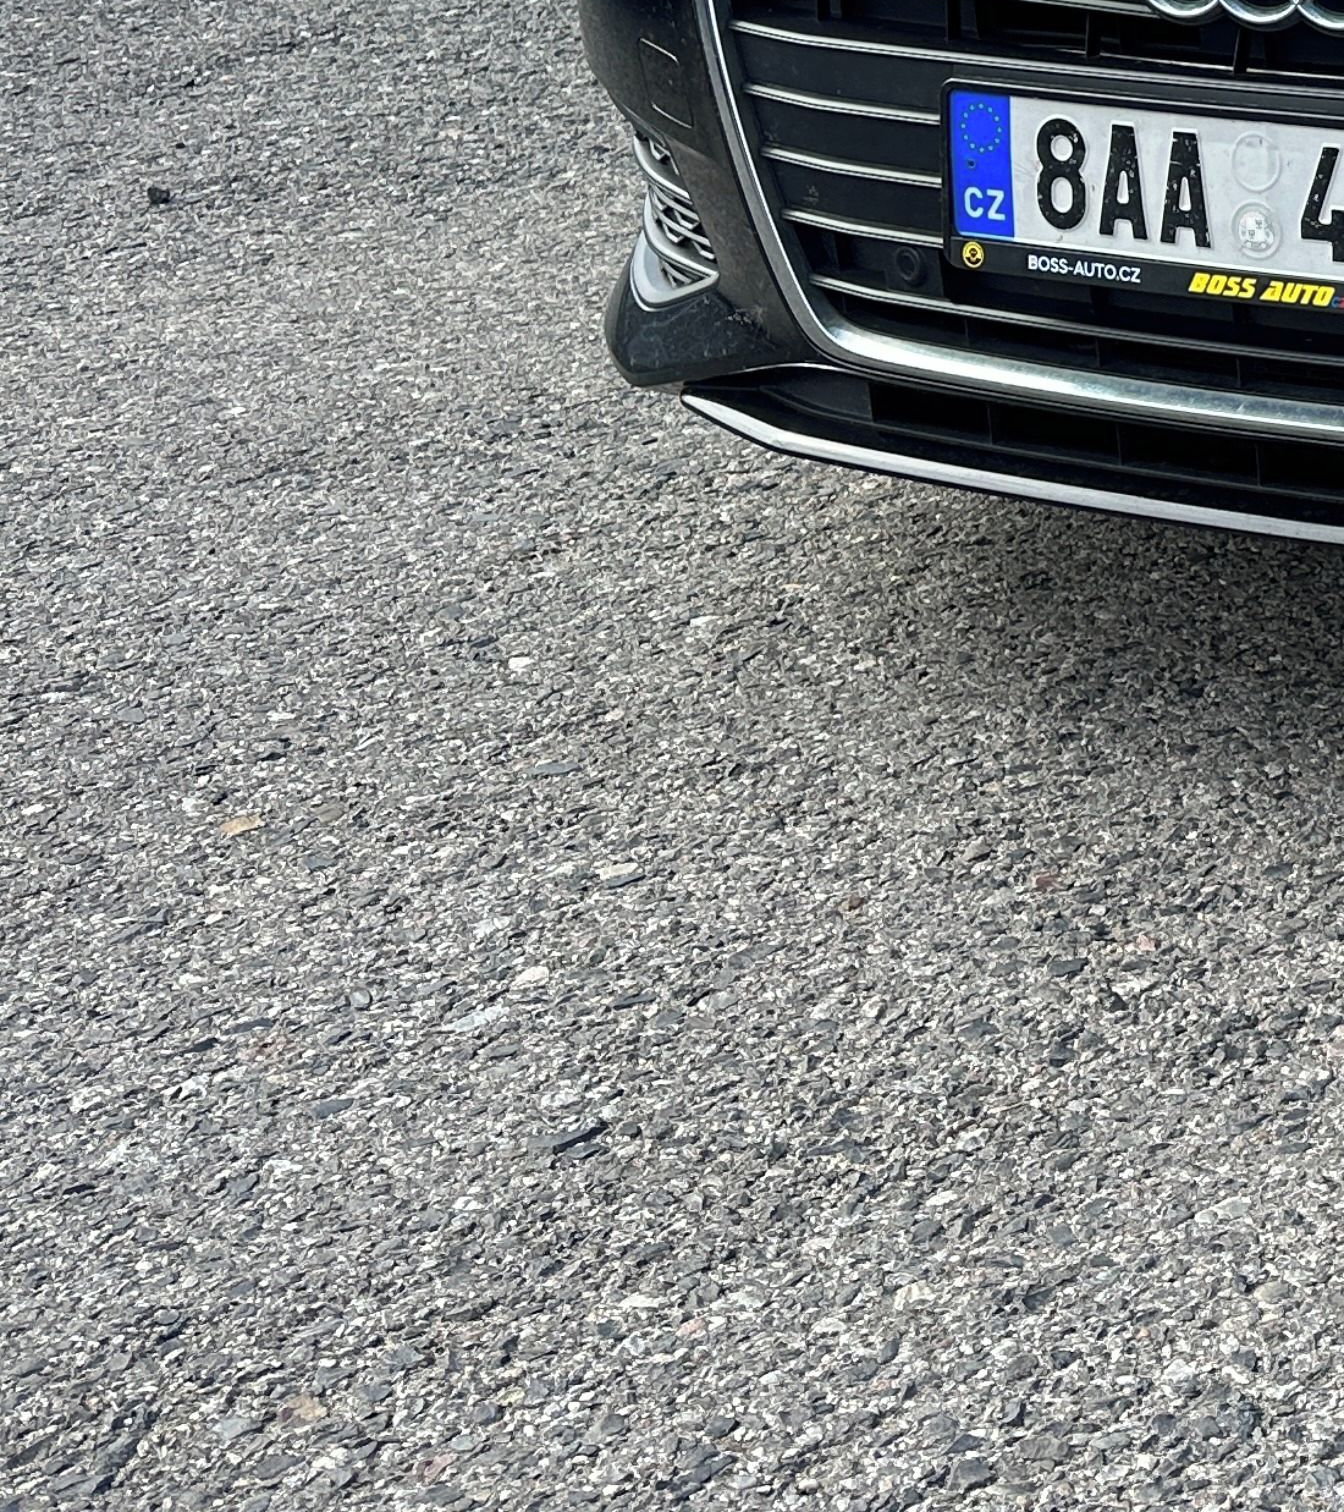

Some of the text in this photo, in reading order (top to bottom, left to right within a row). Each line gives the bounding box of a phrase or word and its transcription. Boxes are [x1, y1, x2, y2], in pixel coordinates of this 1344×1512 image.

[1034, 114, 1212, 250] 8AA
[963, 187, 1006, 222] CZ
[1027, 254, 1142, 284] BOSS-AUTO.CZ
[1188, 272, 1257, 299] BOSS
[1259, 280, 1336, 307] AUTO
